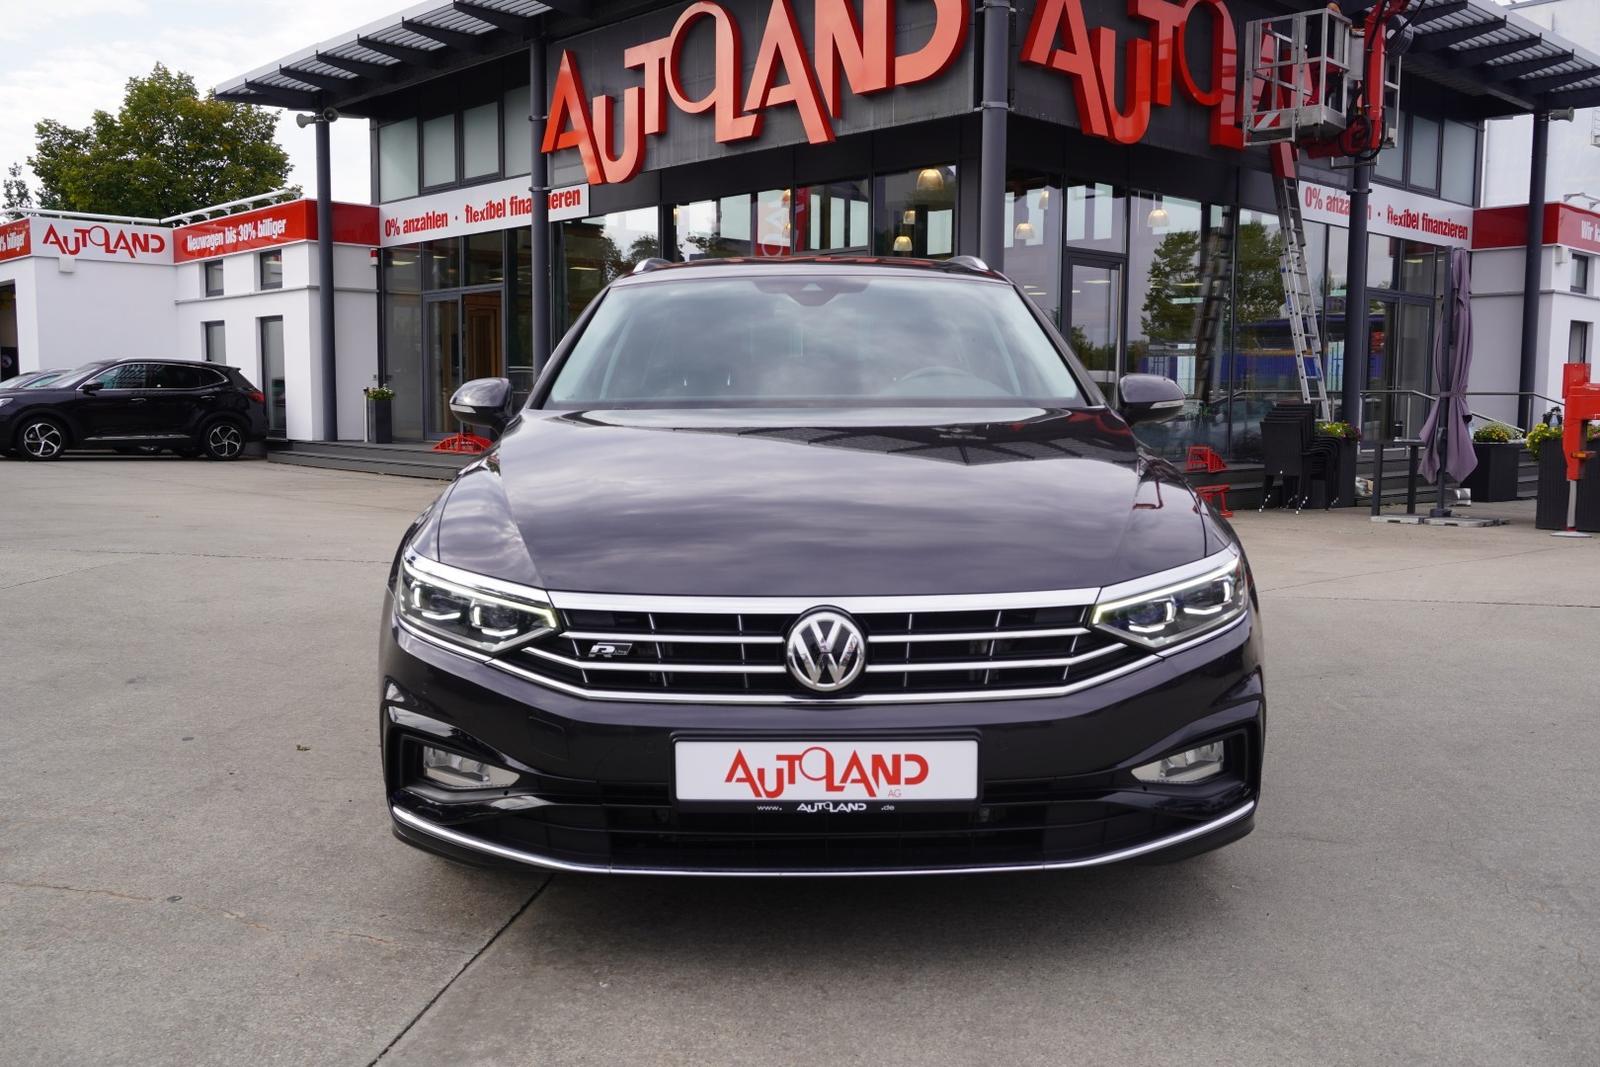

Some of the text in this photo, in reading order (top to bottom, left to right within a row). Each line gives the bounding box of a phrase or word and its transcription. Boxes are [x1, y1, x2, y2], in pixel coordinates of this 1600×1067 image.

[541, 0, 971, 185] AUTOLAND
[225, 227, 236, 244] bis
[238, 222, 256, 241] 30%
[257, 218, 286, 239] billiger
[385, 189, 581, 238] 0% anzahlen flexibel finaieren
[1305, 186, 1323, 210] 0%
[1387, 204, 1419, 230] flexibel
[1421, 212, 1469, 241] finanzieren
[42, 223, 165, 258] AUTOLAND
[725, 746, 929, 799] AUTOLAND
[887, 789, 902, 798] AG
[797, 801, 867, 813] AUTOLAND
[881, 804, 895, 812] .de
